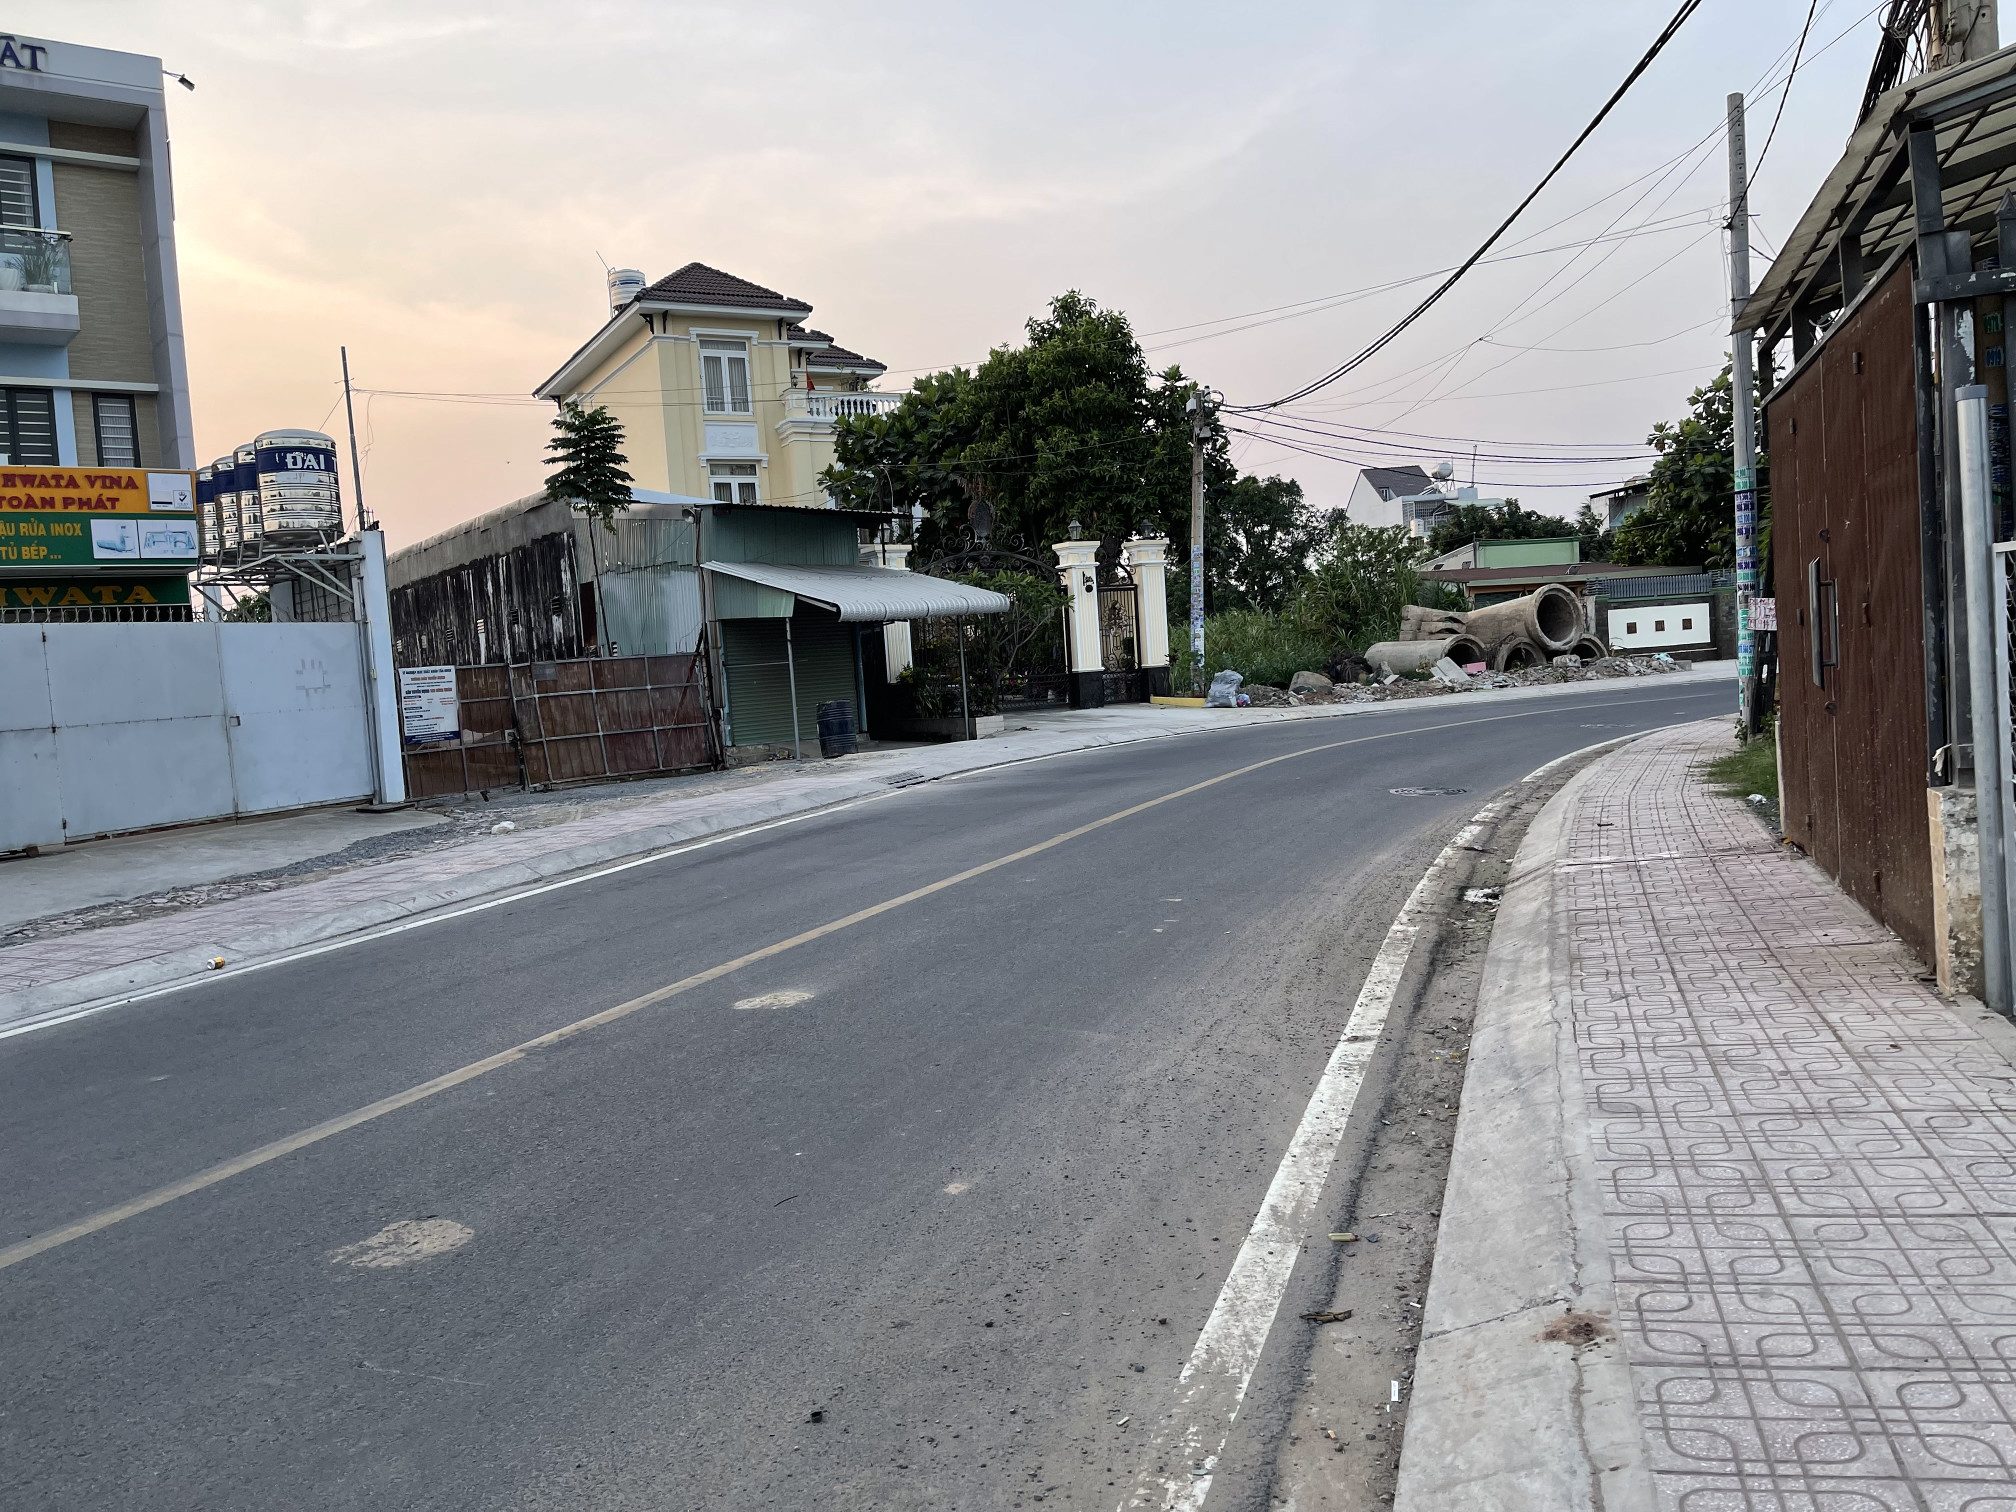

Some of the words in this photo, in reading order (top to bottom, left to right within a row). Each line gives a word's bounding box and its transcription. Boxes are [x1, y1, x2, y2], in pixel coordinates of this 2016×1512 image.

[84, 474, 139, 490] VINA
[62, 494, 120, 510] PHÁT
[19, 517, 47, 537] RỬA
[50, 522, 82, 537] INOX
